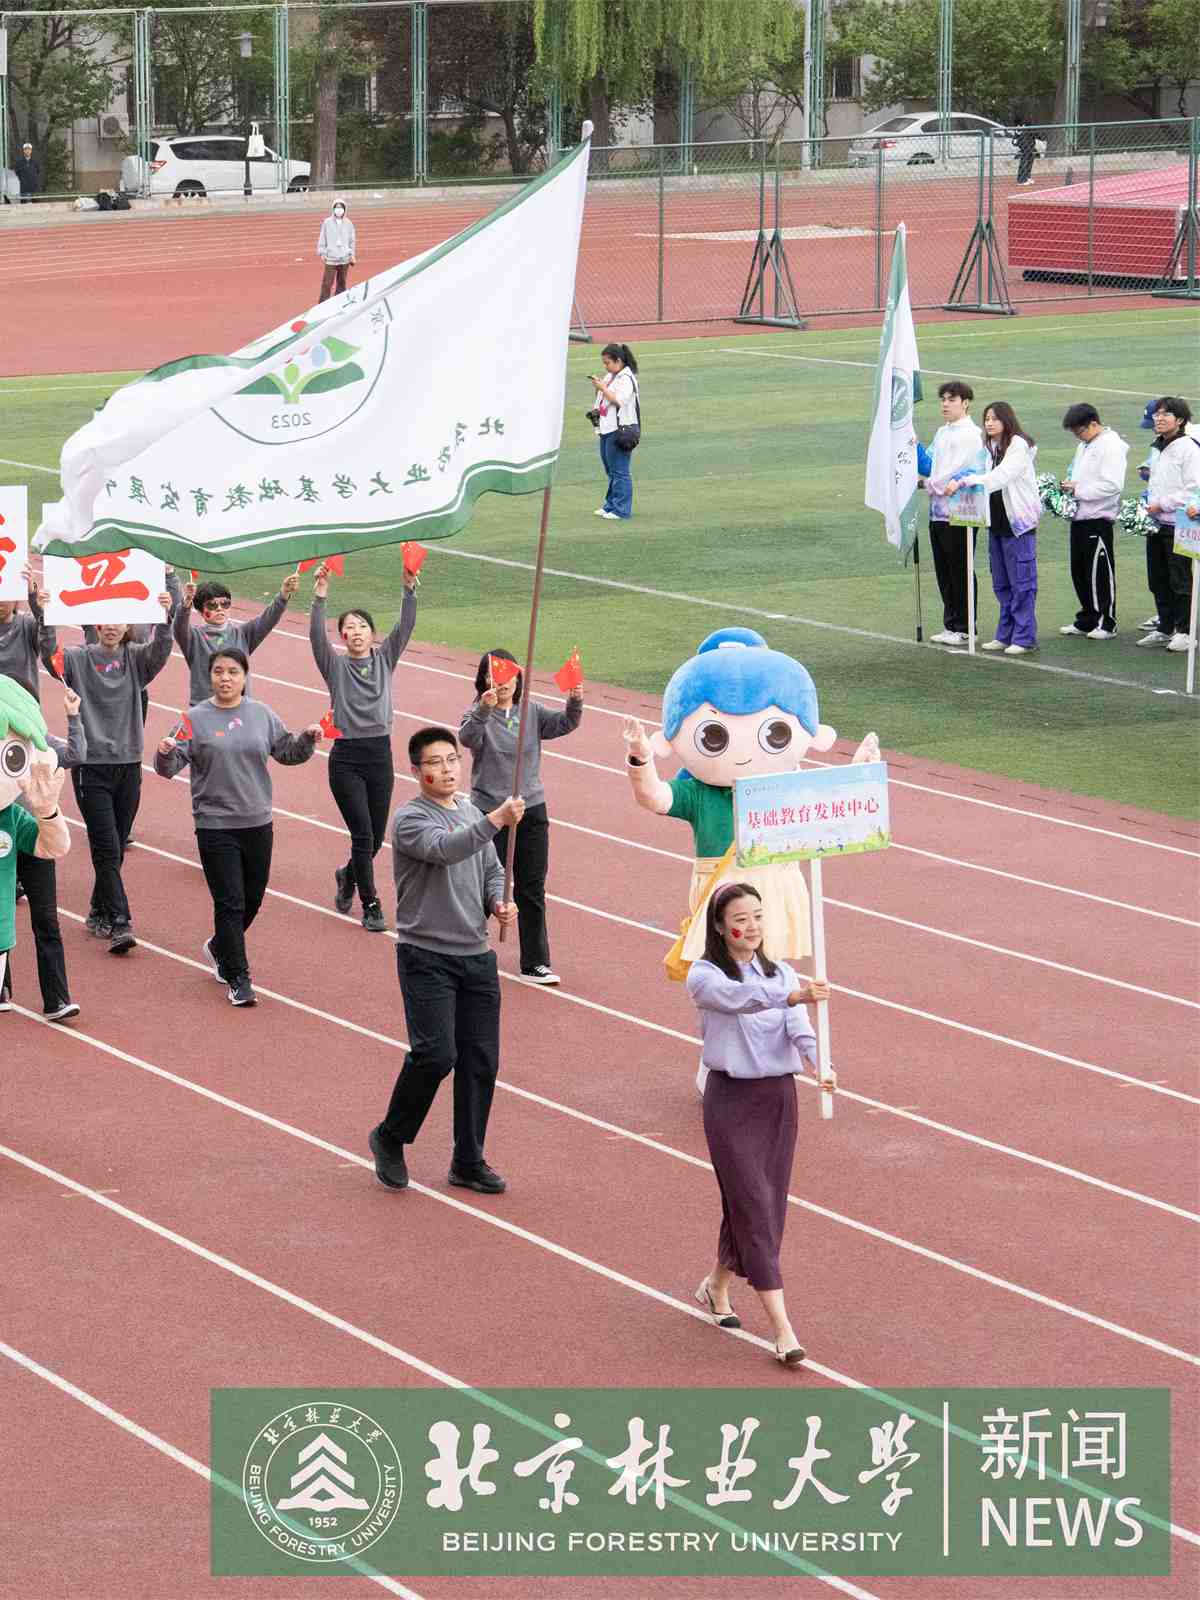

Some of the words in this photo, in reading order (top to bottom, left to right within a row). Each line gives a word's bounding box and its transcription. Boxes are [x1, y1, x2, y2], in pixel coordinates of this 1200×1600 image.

[58, 549, 150, 607] 立
[746, 797, 880, 829] 基础教育发展中心
